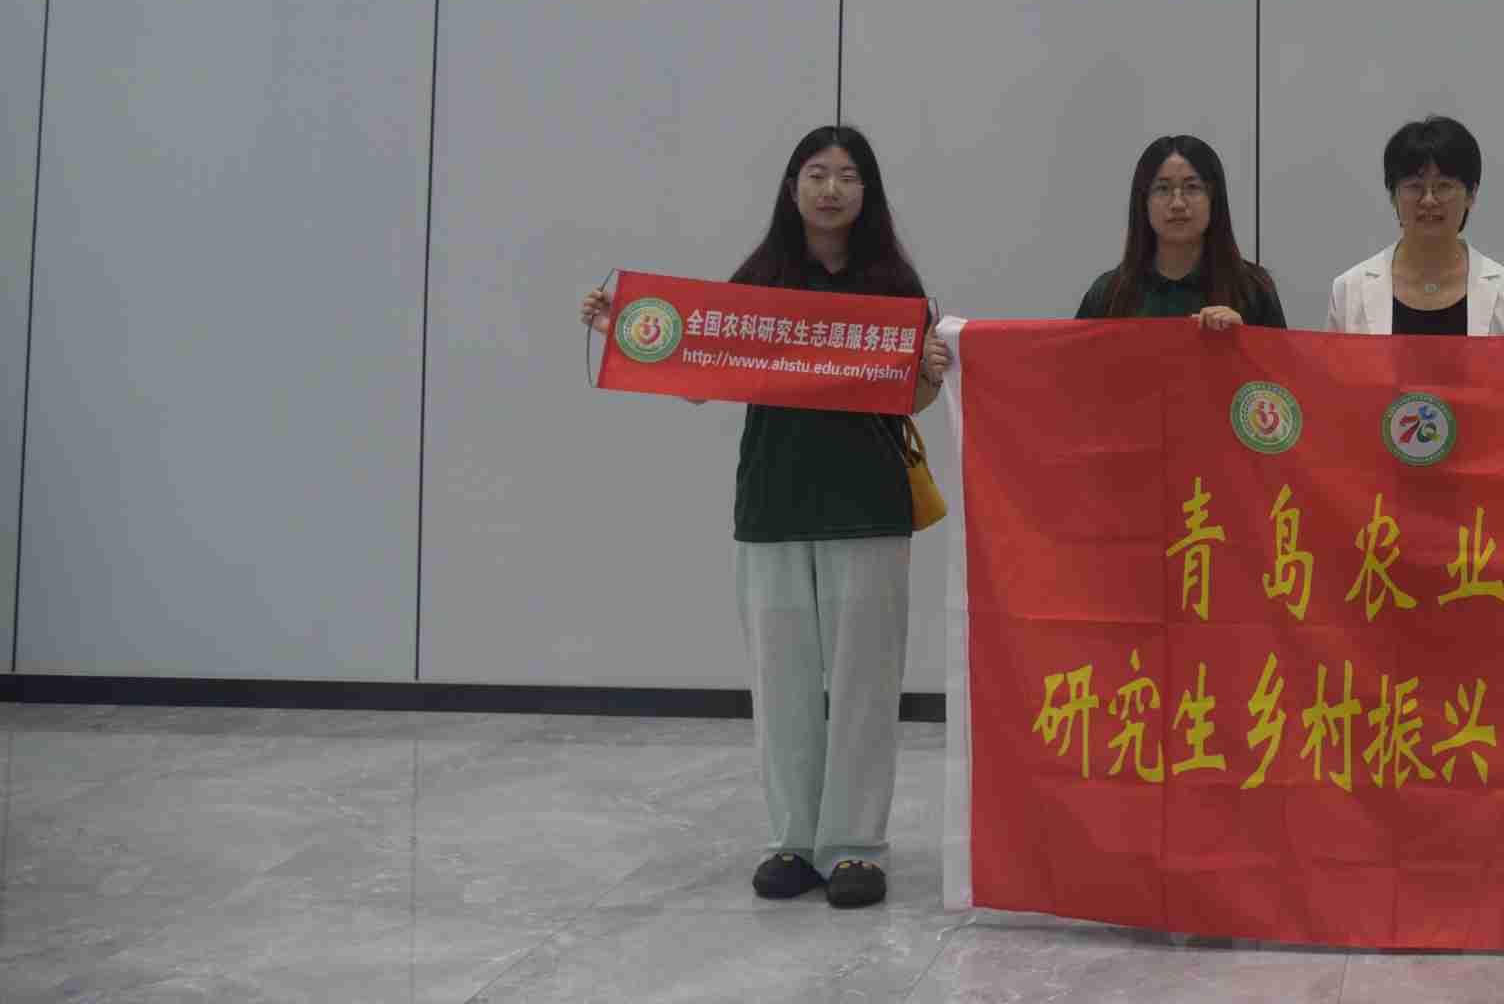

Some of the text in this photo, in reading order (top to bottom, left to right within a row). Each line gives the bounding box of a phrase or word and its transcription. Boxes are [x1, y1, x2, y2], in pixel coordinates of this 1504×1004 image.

[685, 308, 916, 354] 全国农科研究生志愿服务联盟
